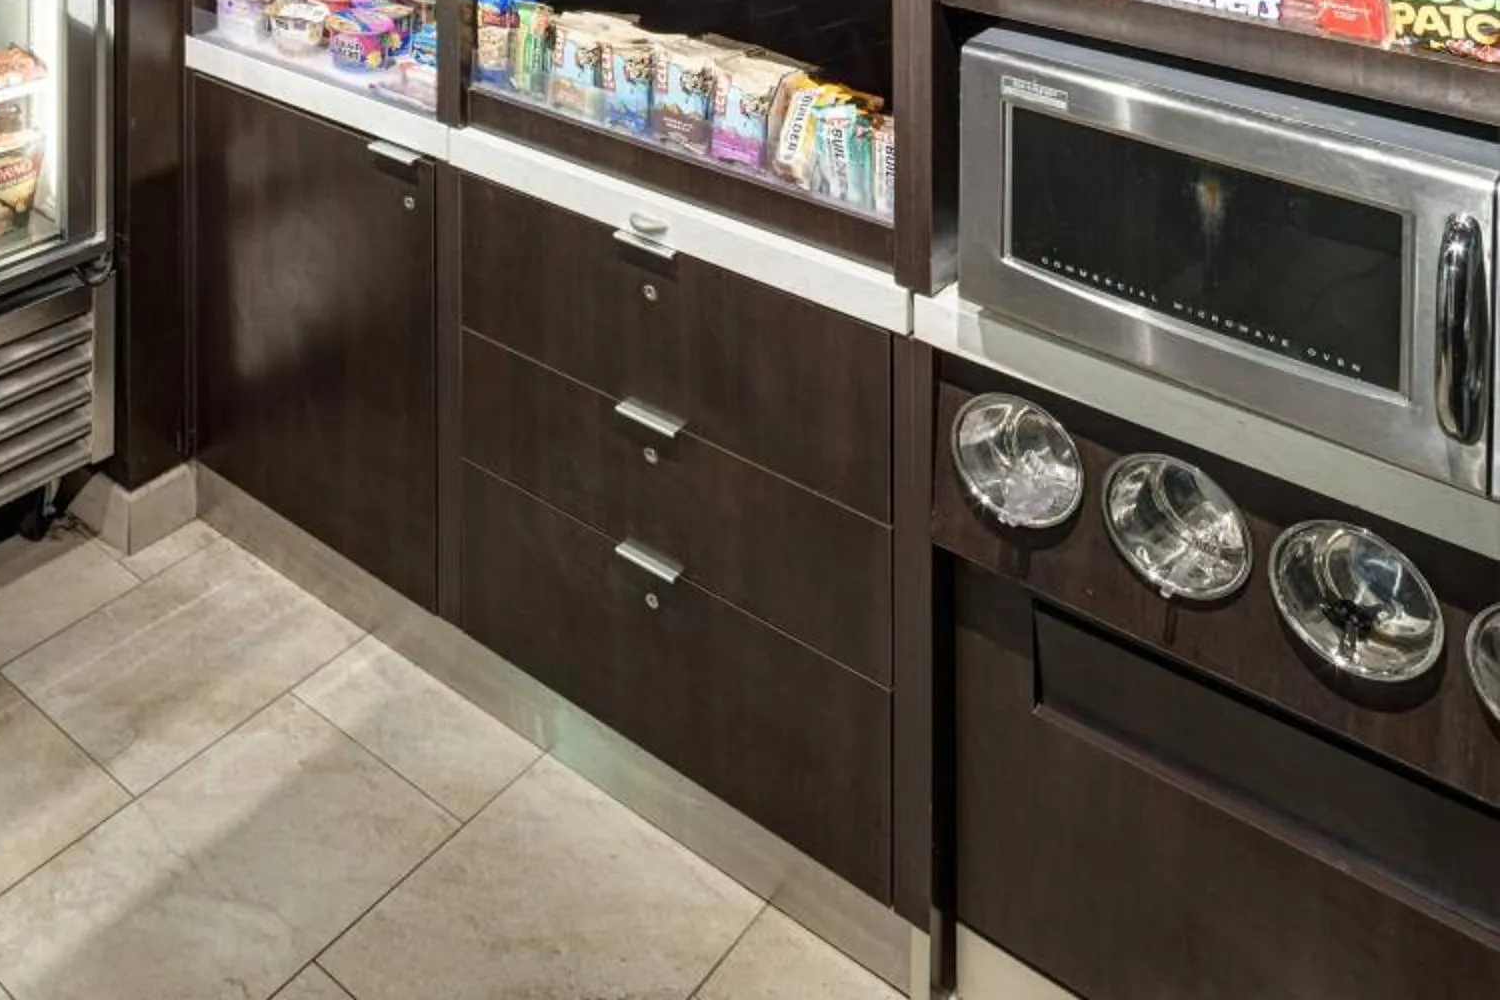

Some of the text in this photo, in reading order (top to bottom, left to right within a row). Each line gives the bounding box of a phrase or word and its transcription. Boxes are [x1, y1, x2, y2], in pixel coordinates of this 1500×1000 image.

[1392, 5, 1500, 46] PATC
[1040, 256, 1362, 373] COMMERCIAL MICROWAVE OVEN
